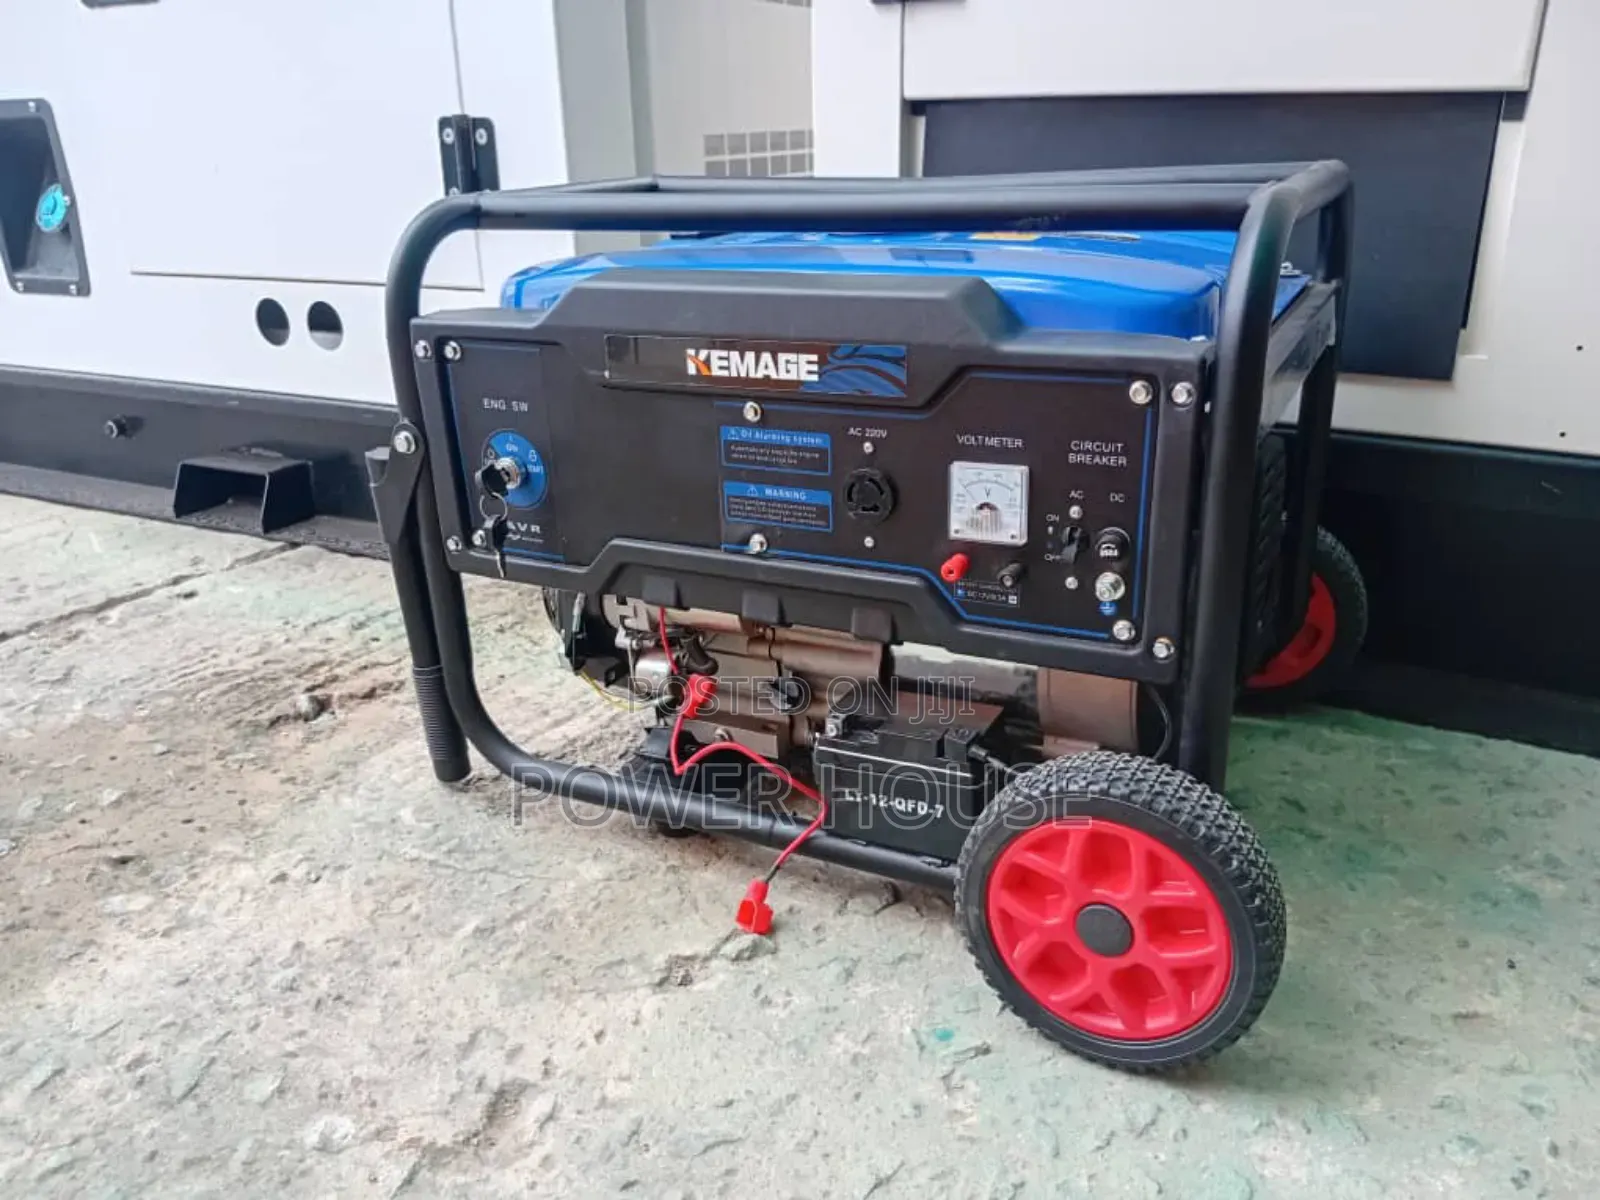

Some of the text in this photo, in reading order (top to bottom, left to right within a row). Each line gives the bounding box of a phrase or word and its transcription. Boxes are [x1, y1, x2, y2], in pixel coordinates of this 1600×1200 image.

[686, 348, 819, 382] KEMAGE
[483, 397, 528, 412] ENG SW
[848, 427, 887, 438] AC 220V
[1070, 440, 1124, 453] CIRCUIT
[1067, 452, 1127, 467] BREAKER
[764, 487, 807, 501] WARNING
[1069, 490, 1084, 500] AC
[1109, 492, 1125, 503] DC
[1046, 514, 1060, 522] ON
